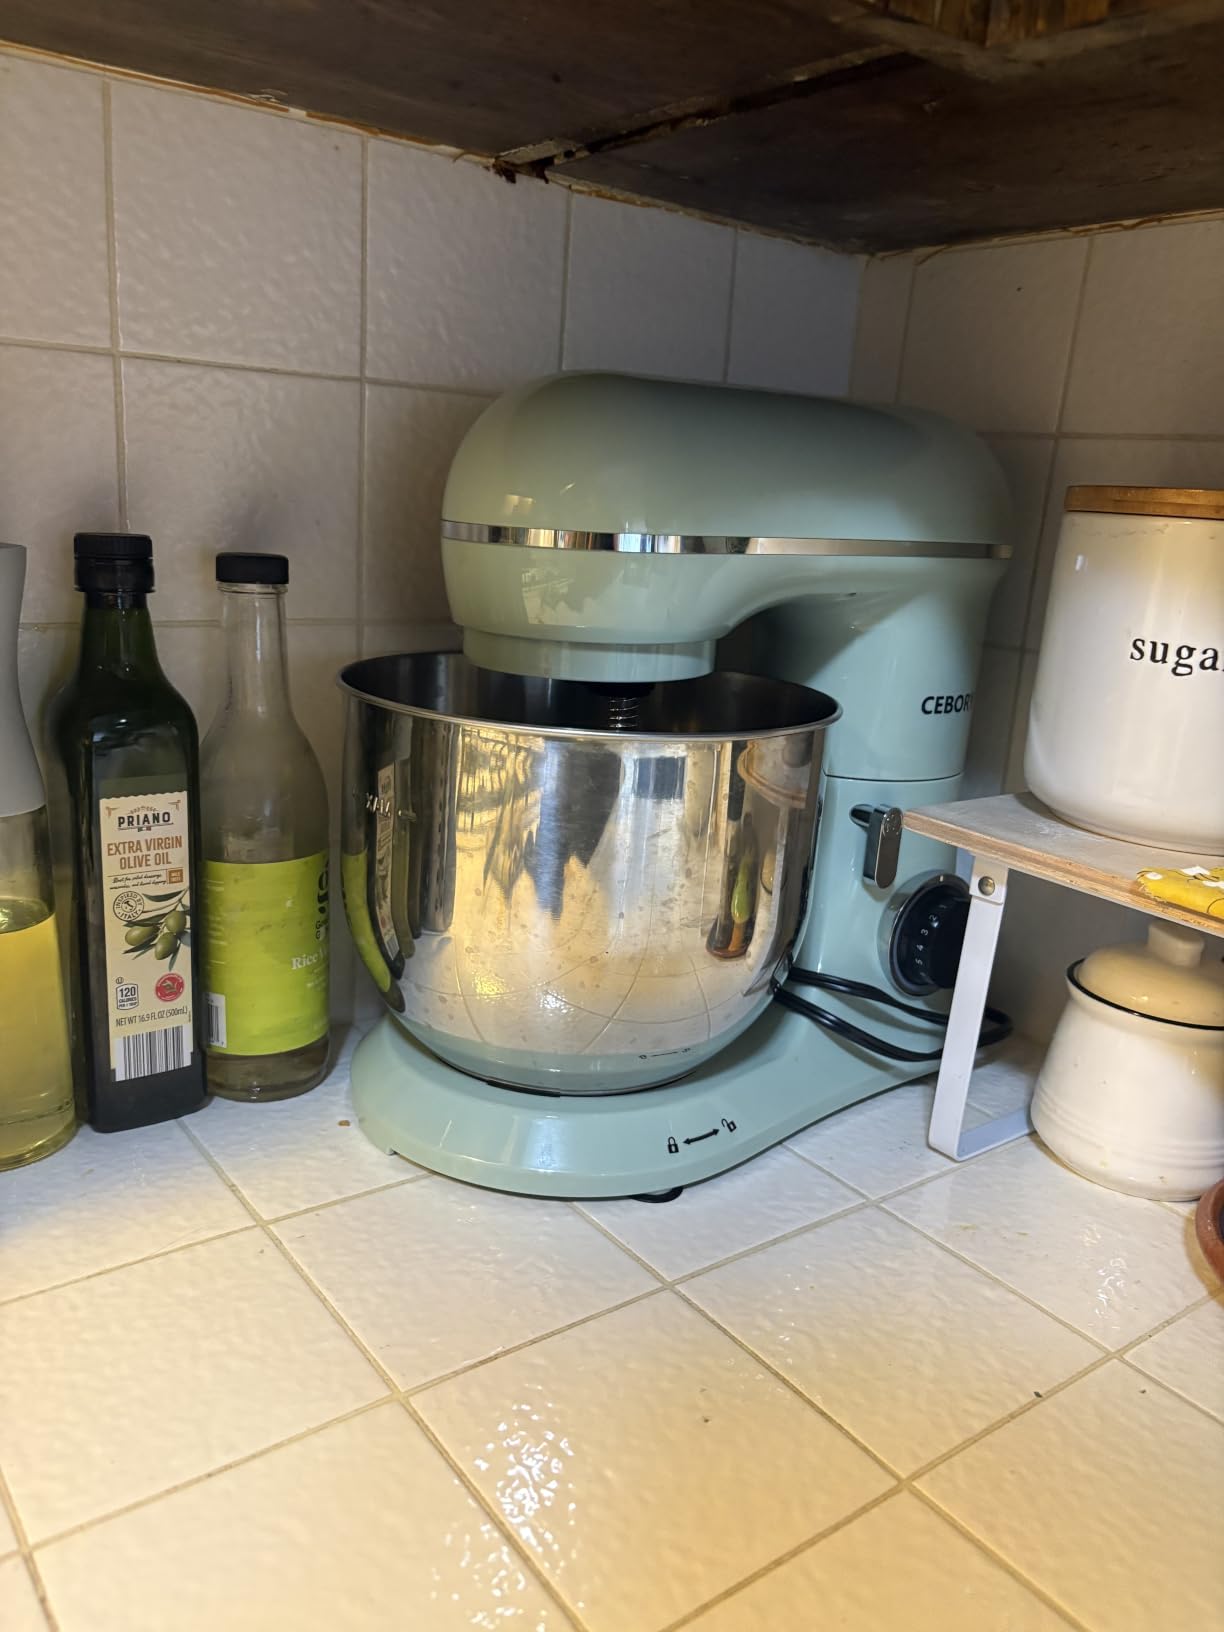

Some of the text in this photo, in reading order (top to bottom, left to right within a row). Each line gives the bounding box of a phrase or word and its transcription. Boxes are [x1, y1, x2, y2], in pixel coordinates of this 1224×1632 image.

[1129, 638, 1224, 677] suga
[921, 693, 973, 715] CEBOR
[117, 811, 171, 828] PRIANO
[106, 835, 183, 857] EXTRA VIRGIN
[119, 851, 172, 870] OLIVE OIL
[115, 892, 138, 909] INSPIRED
[120, 910, 141, 920] ITALY
[920, 928, 929, 936] 3
[291, 953, 319, 971] Rice
[915, 957, 923, 966] 5
[119, 986, 136, 998] 120
[115, 1018, 127, 1027] NET
[128, 1016, 137, 1025] WT
[138, 1013, 151, 1023] 16.9
[150, 1012, 158, 1021] FL
[157, 1010, 165, 1019] OZ
